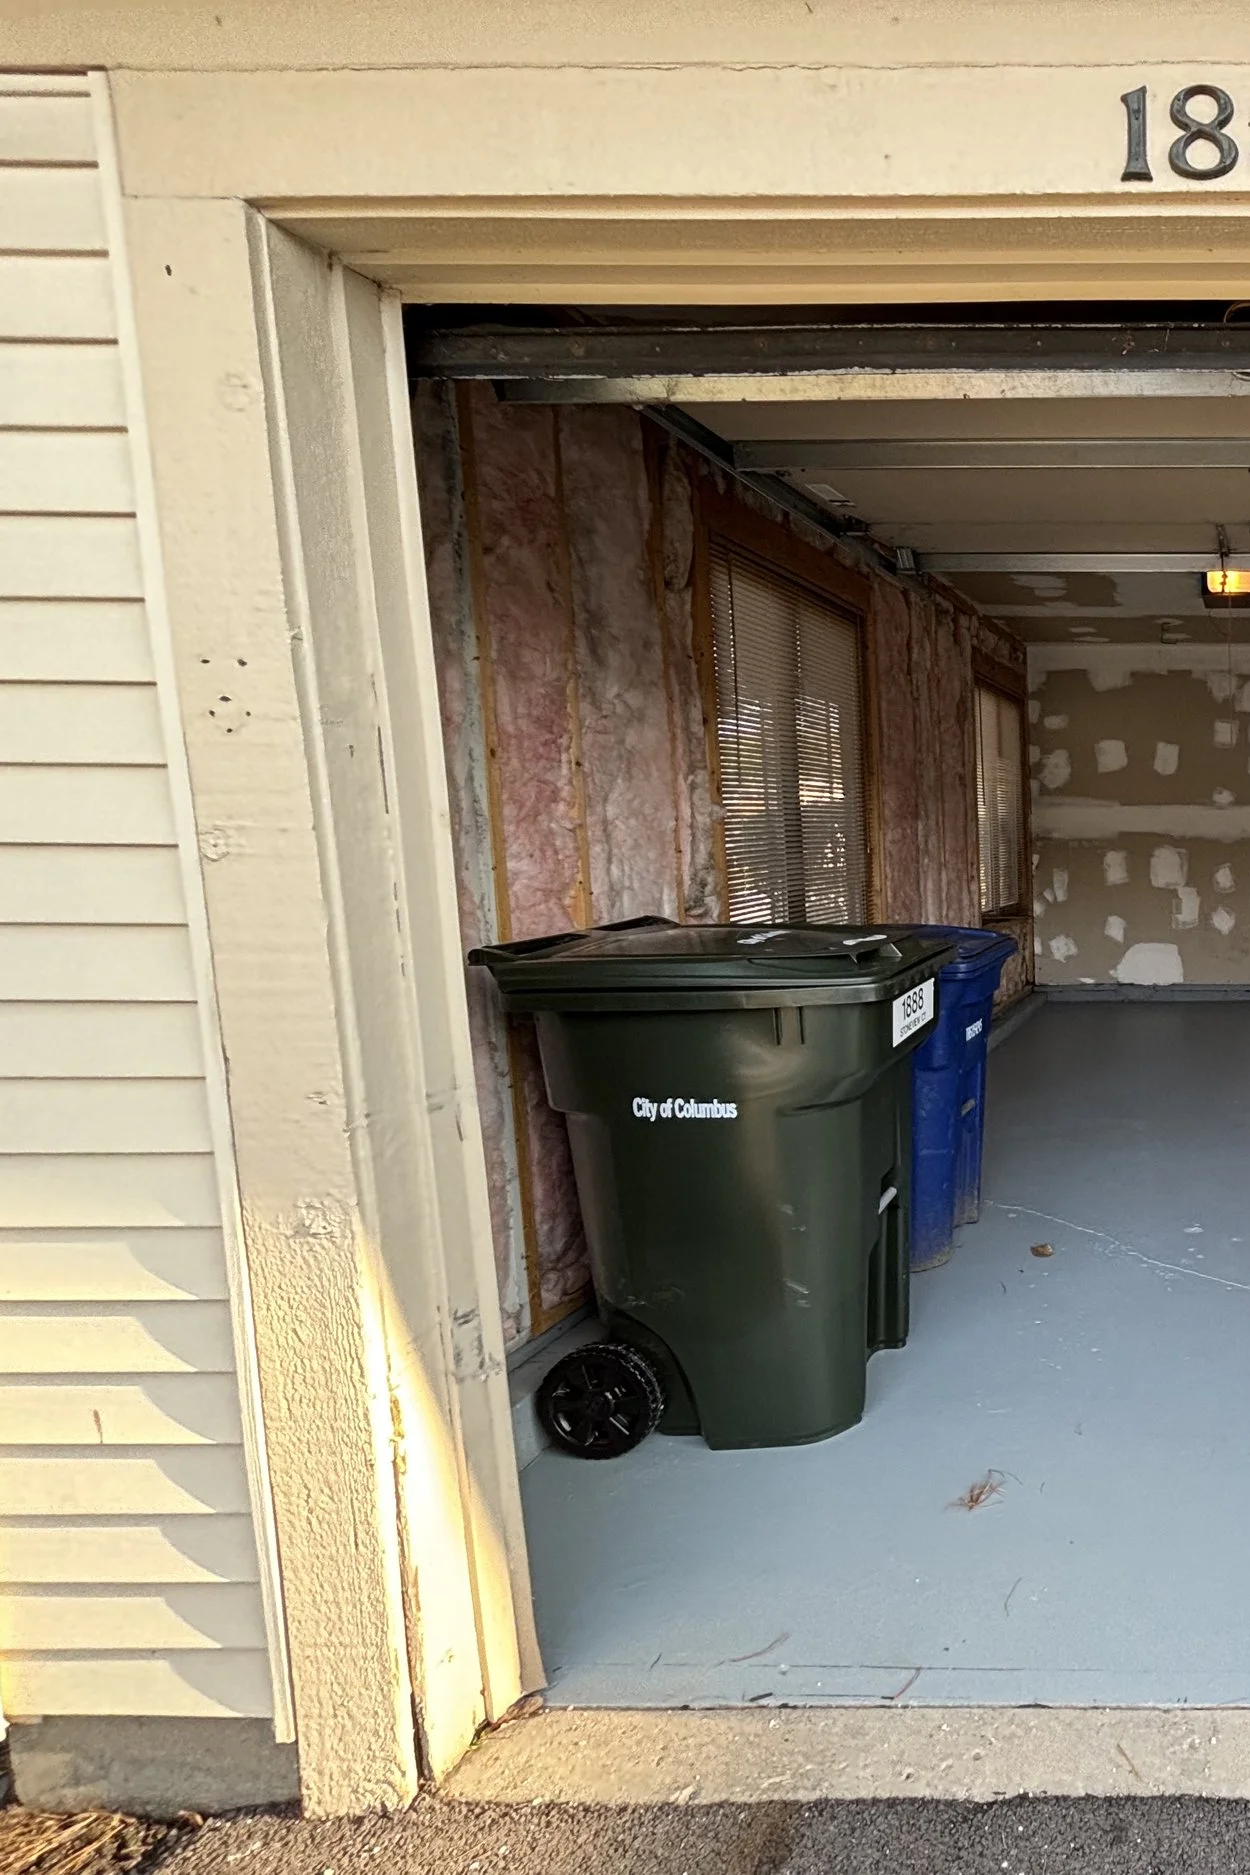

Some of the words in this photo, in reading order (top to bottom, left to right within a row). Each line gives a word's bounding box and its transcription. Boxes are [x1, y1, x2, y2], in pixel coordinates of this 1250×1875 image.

[901, 987, 924, 1020] 1888
[632, 1097, 658, 1122] City
[659, 1098, 673, 1118] of
[674, 1098, 738, 1119] Columbus
